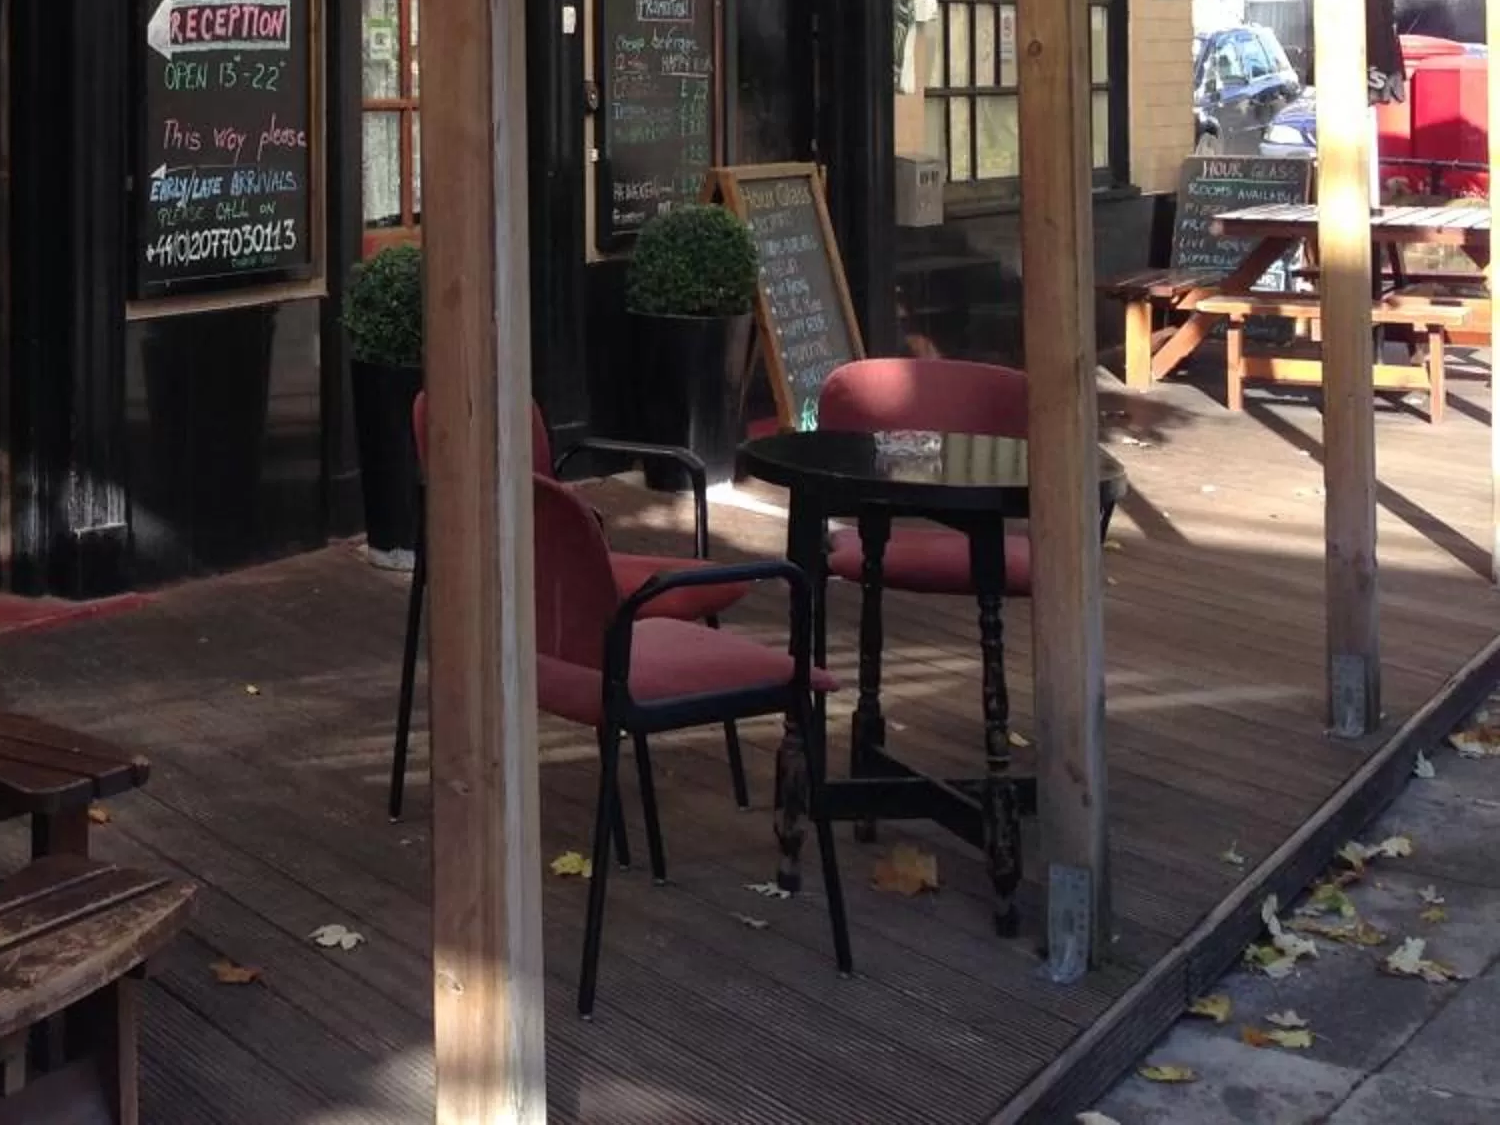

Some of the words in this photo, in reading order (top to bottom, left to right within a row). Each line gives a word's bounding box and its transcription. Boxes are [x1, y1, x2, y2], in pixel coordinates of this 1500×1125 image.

[170, 5, 286, 43] RECEPTION
[164, 60, 208, 91] OPEN
[163, 118, 202, 152] This
[256, 111, 308, 162] please
[229, 170, 298, 197] ARRIVALS
[215, 198, 250, 221] CALL
